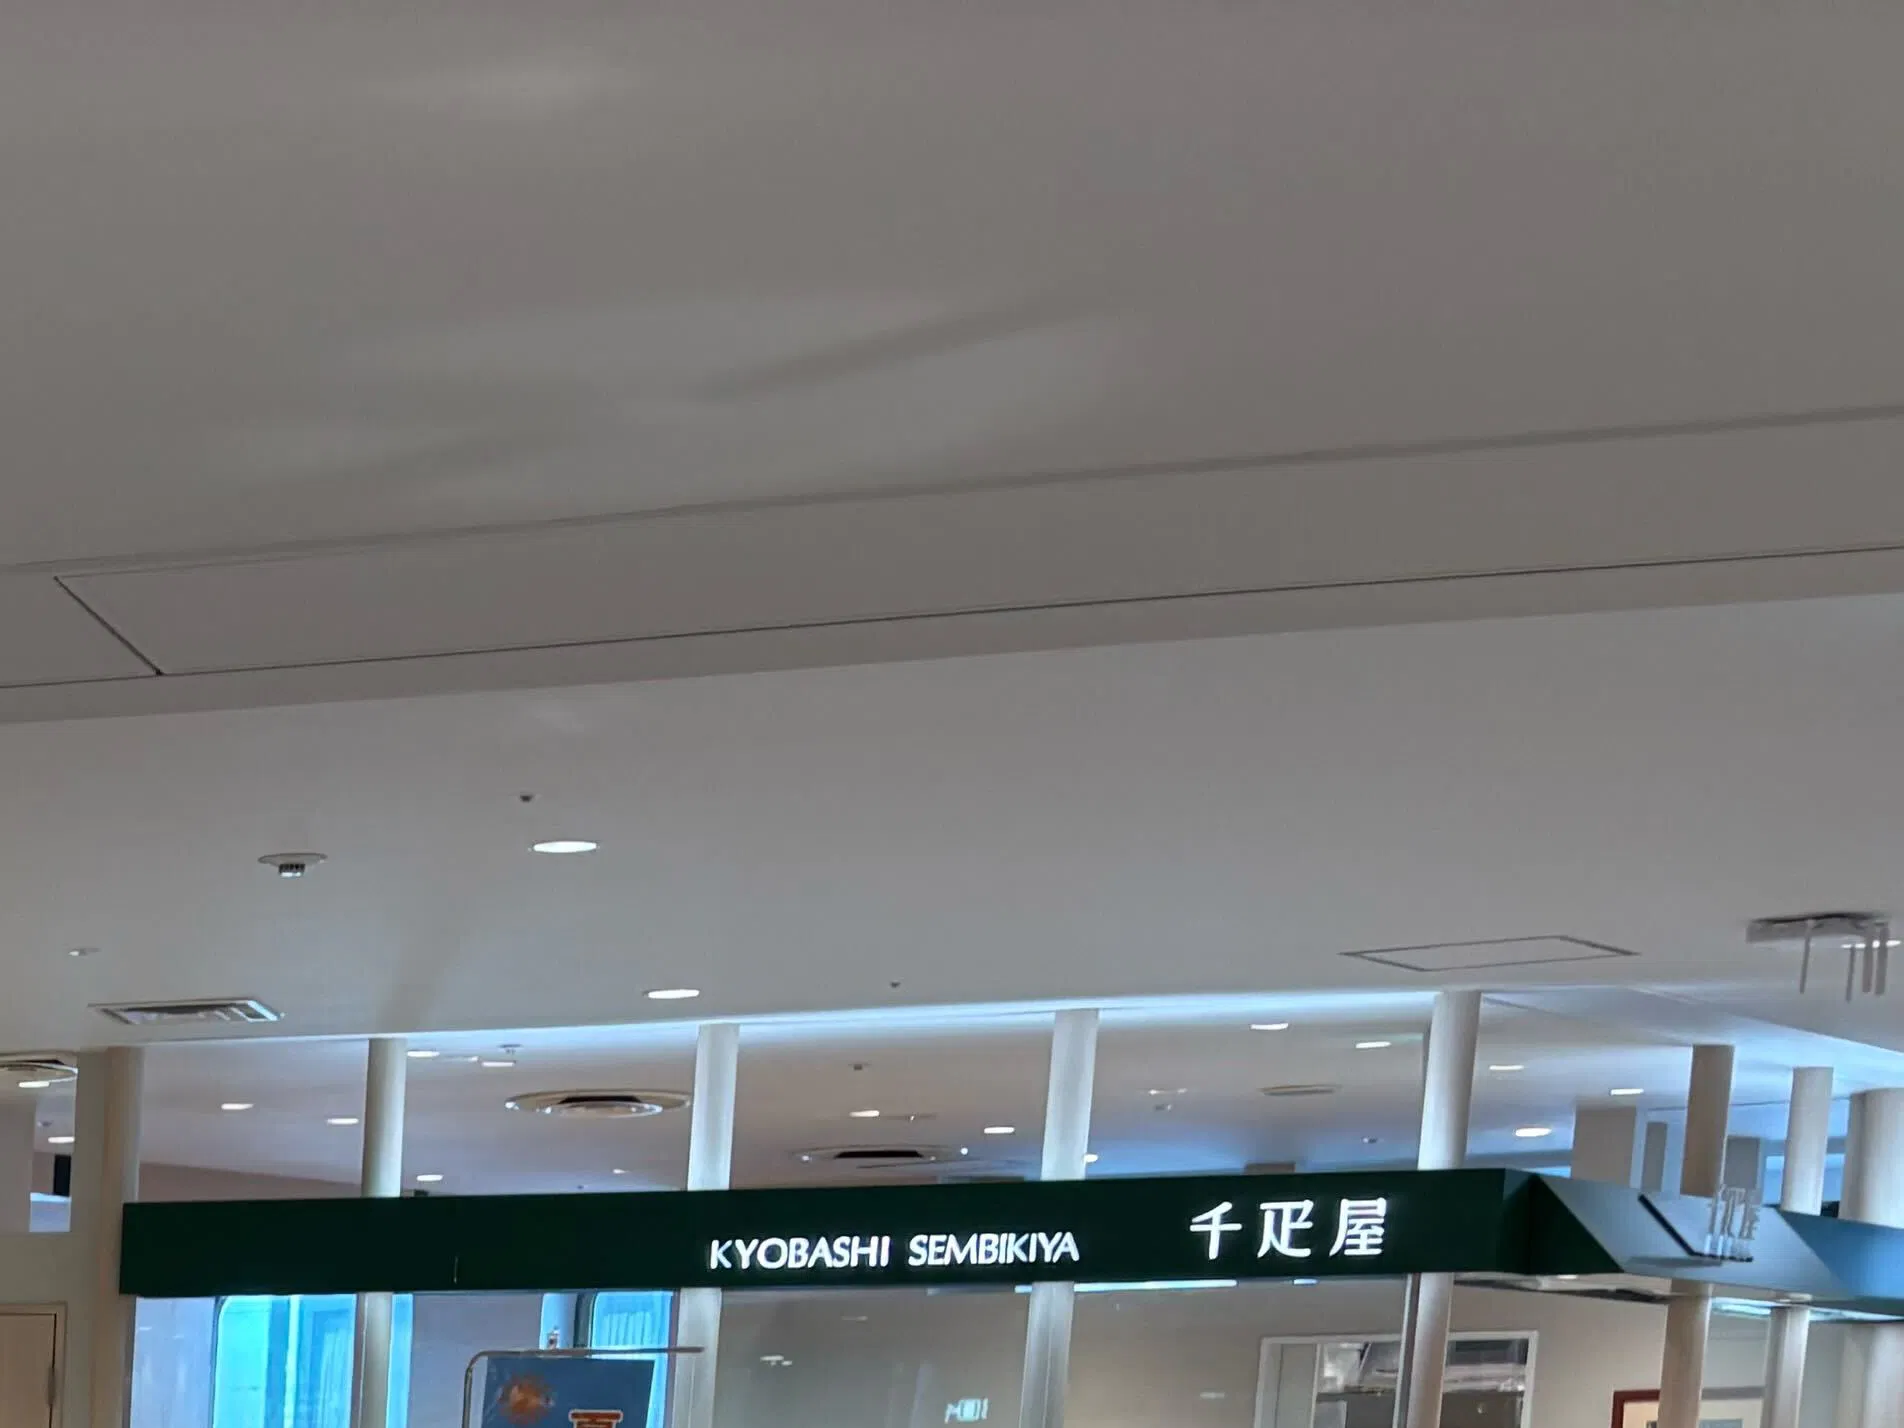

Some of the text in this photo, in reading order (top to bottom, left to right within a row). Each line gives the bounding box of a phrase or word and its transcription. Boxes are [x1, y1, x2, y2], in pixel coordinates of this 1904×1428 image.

[710, 1231, 1082, 1271] KYOBASHI SEMBIKIYA
[1189, 1197, 1389, 1262] 千疋屋
